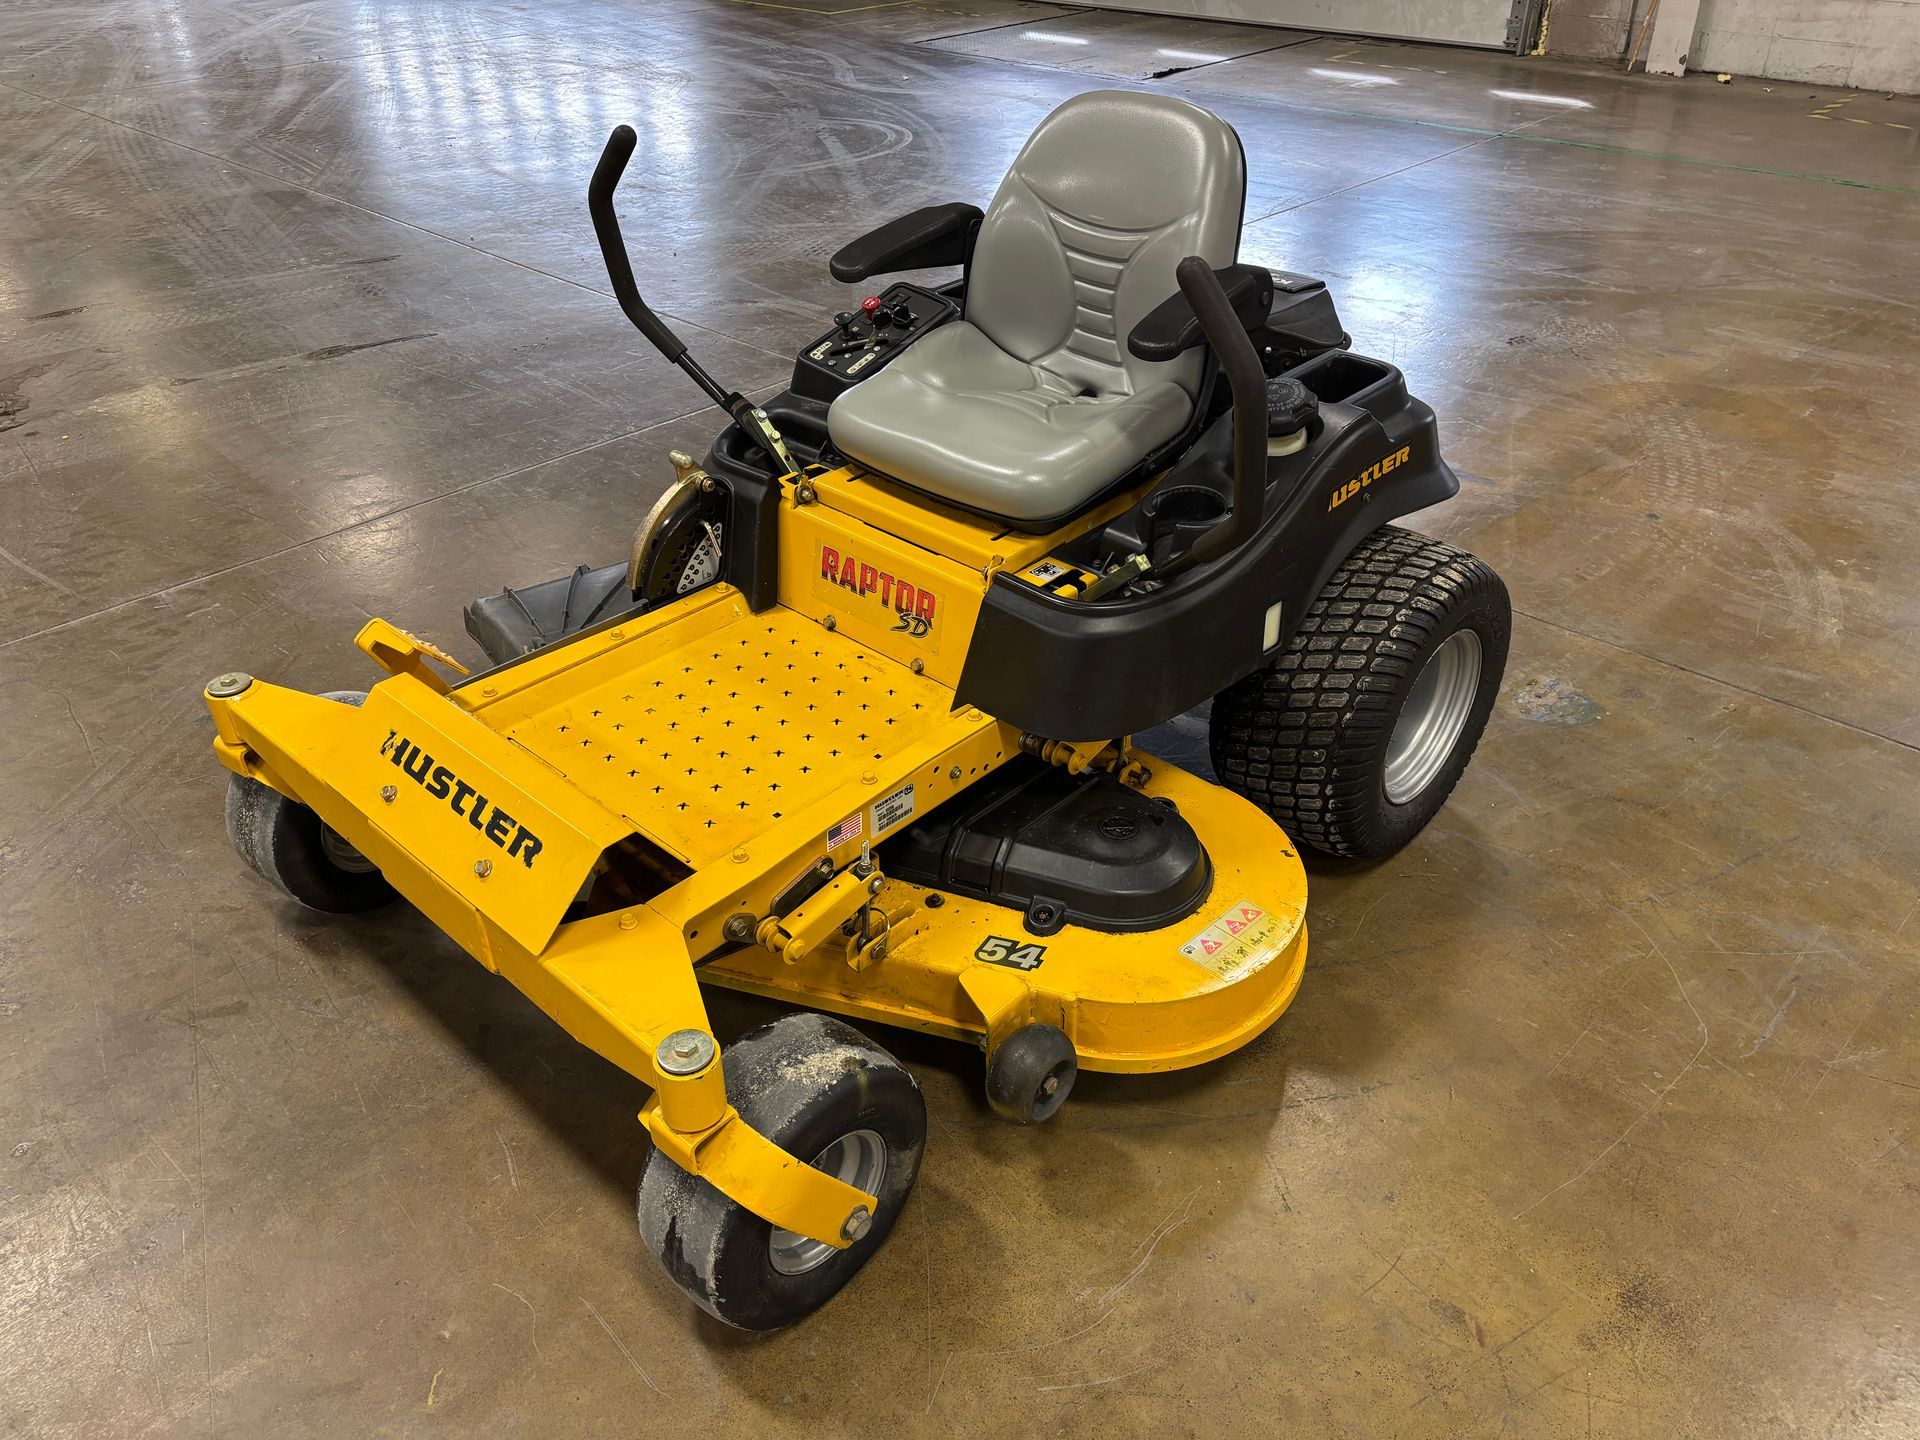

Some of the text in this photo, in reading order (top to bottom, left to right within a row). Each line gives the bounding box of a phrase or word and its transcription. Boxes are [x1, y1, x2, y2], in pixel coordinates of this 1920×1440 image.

[1328, 445, 1411, 512] USTLER
[821, 545, 936, 629] RAPTOR
[890, 611, 930, 638] SD
[977, 937, 1043, 969] 54
